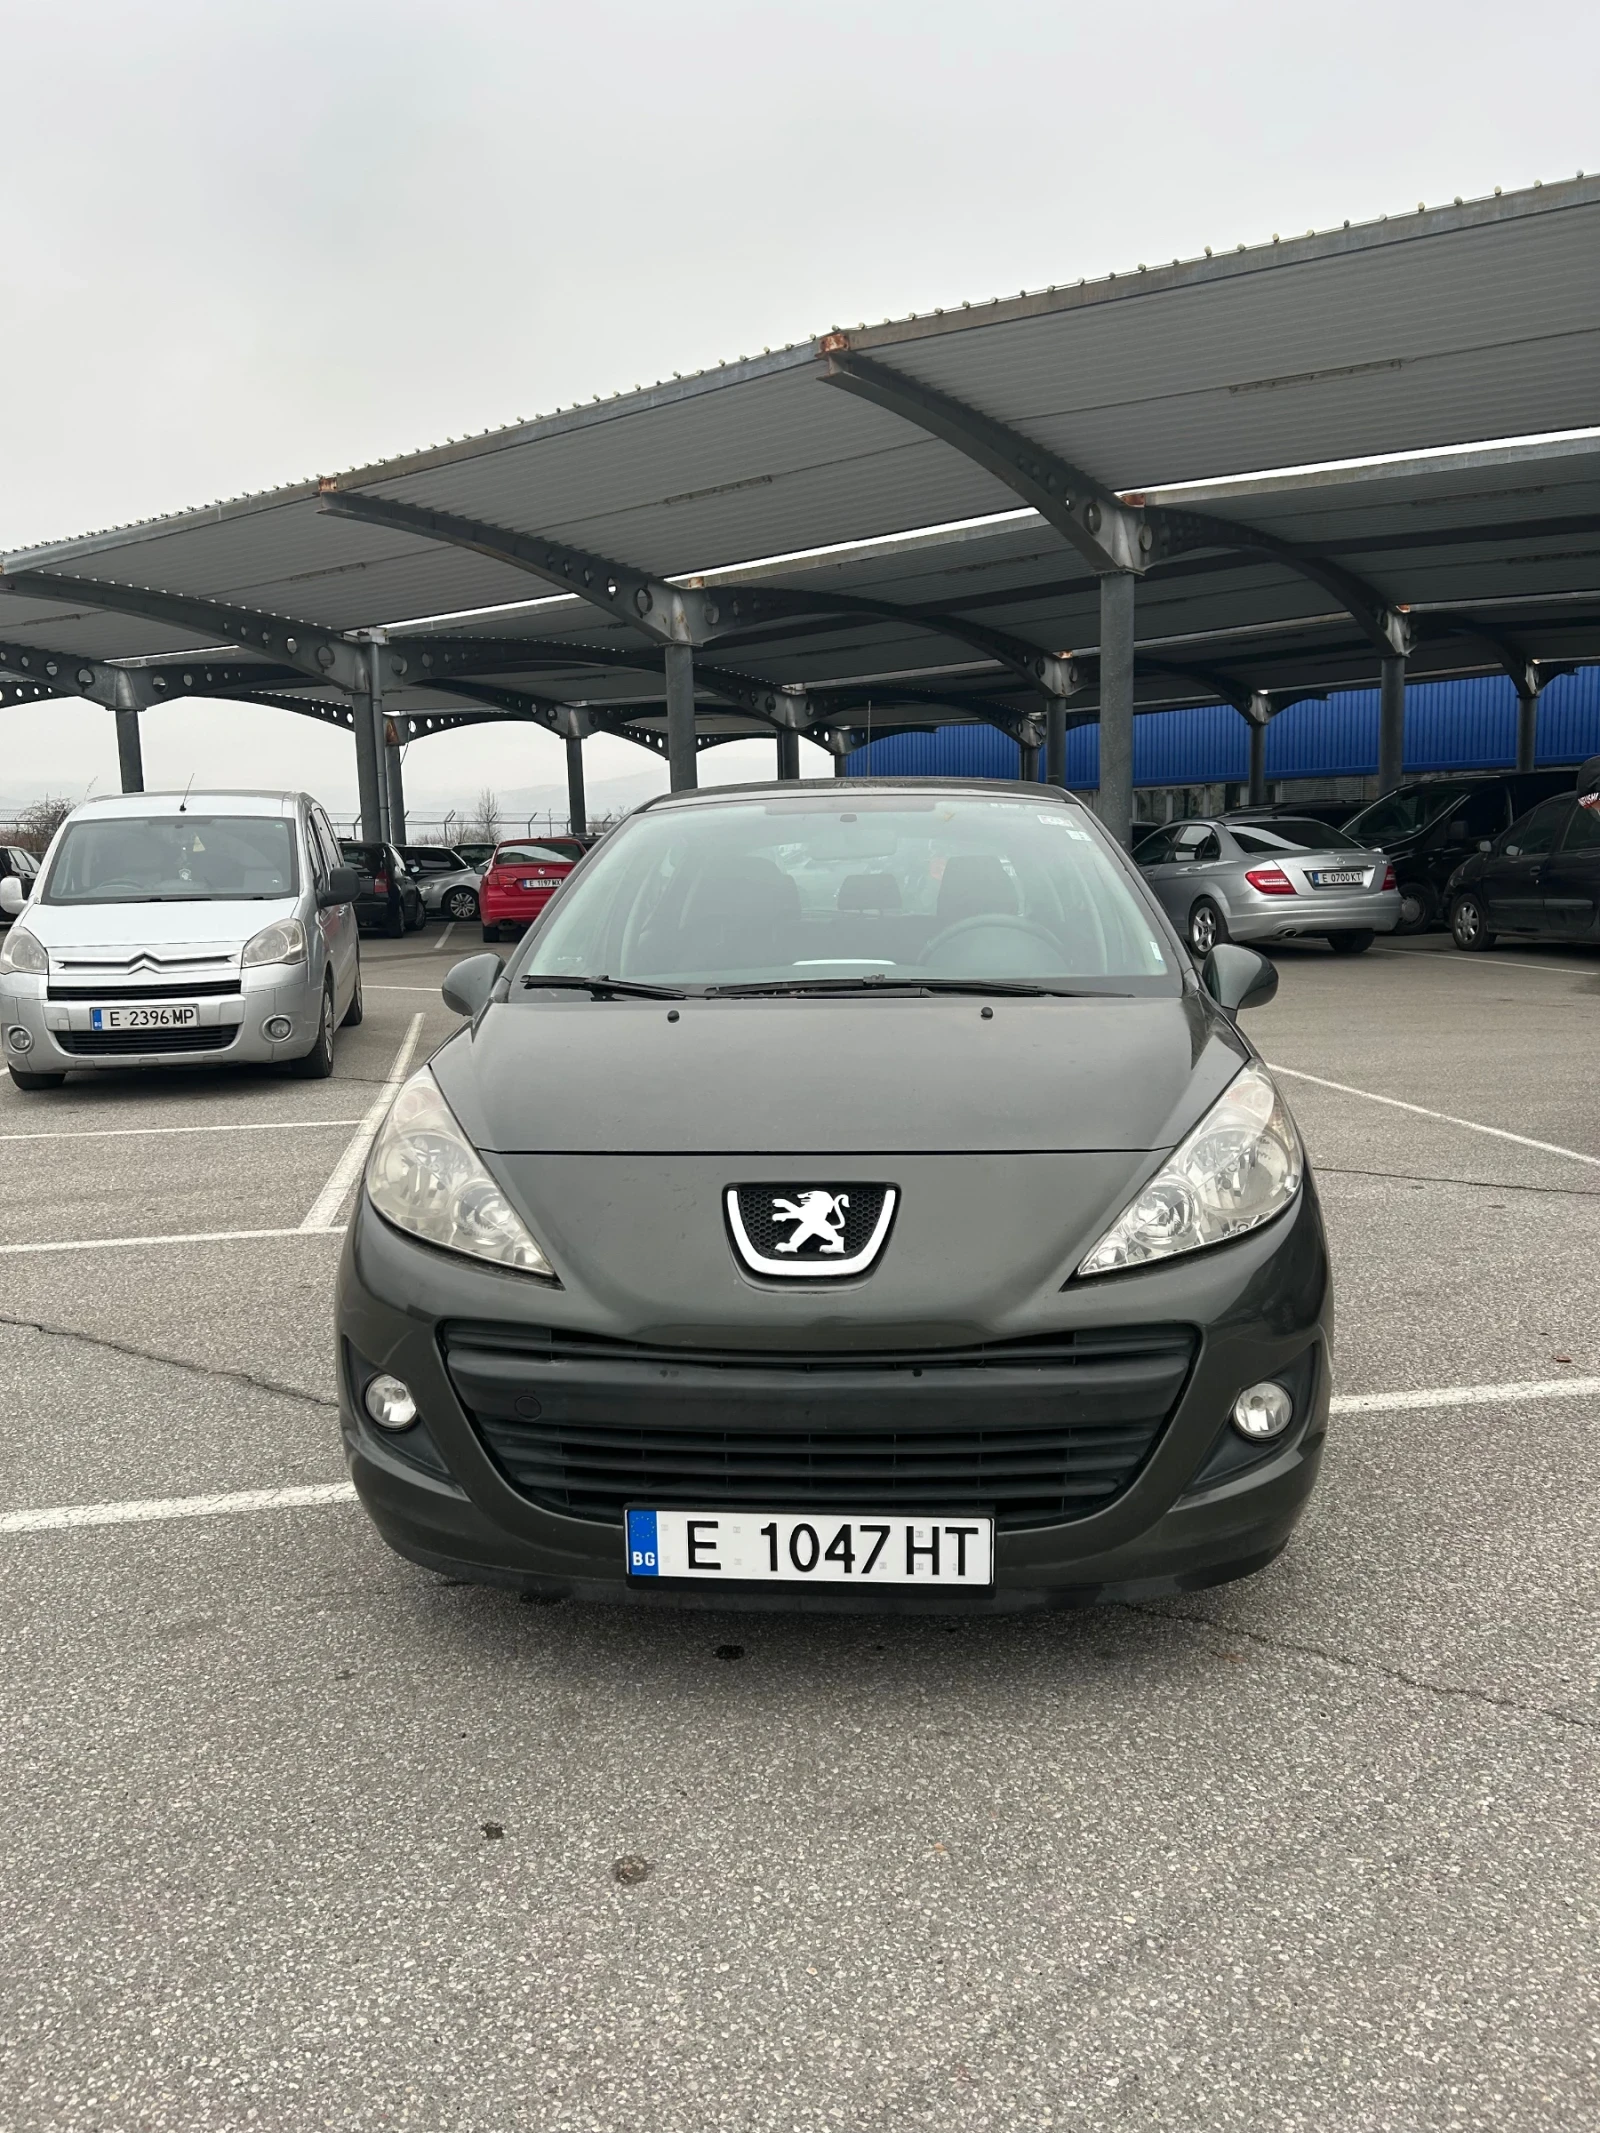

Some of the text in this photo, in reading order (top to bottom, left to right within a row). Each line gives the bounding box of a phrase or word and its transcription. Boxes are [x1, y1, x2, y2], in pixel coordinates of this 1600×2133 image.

[1322, 872, 1361, 882] E 0700 KT
[110, 1009, 194, 1026] E 2396 MP
[687, 1520, 979, 1576] E 1047 HT
[632, 1551, 656, 1567] BG
